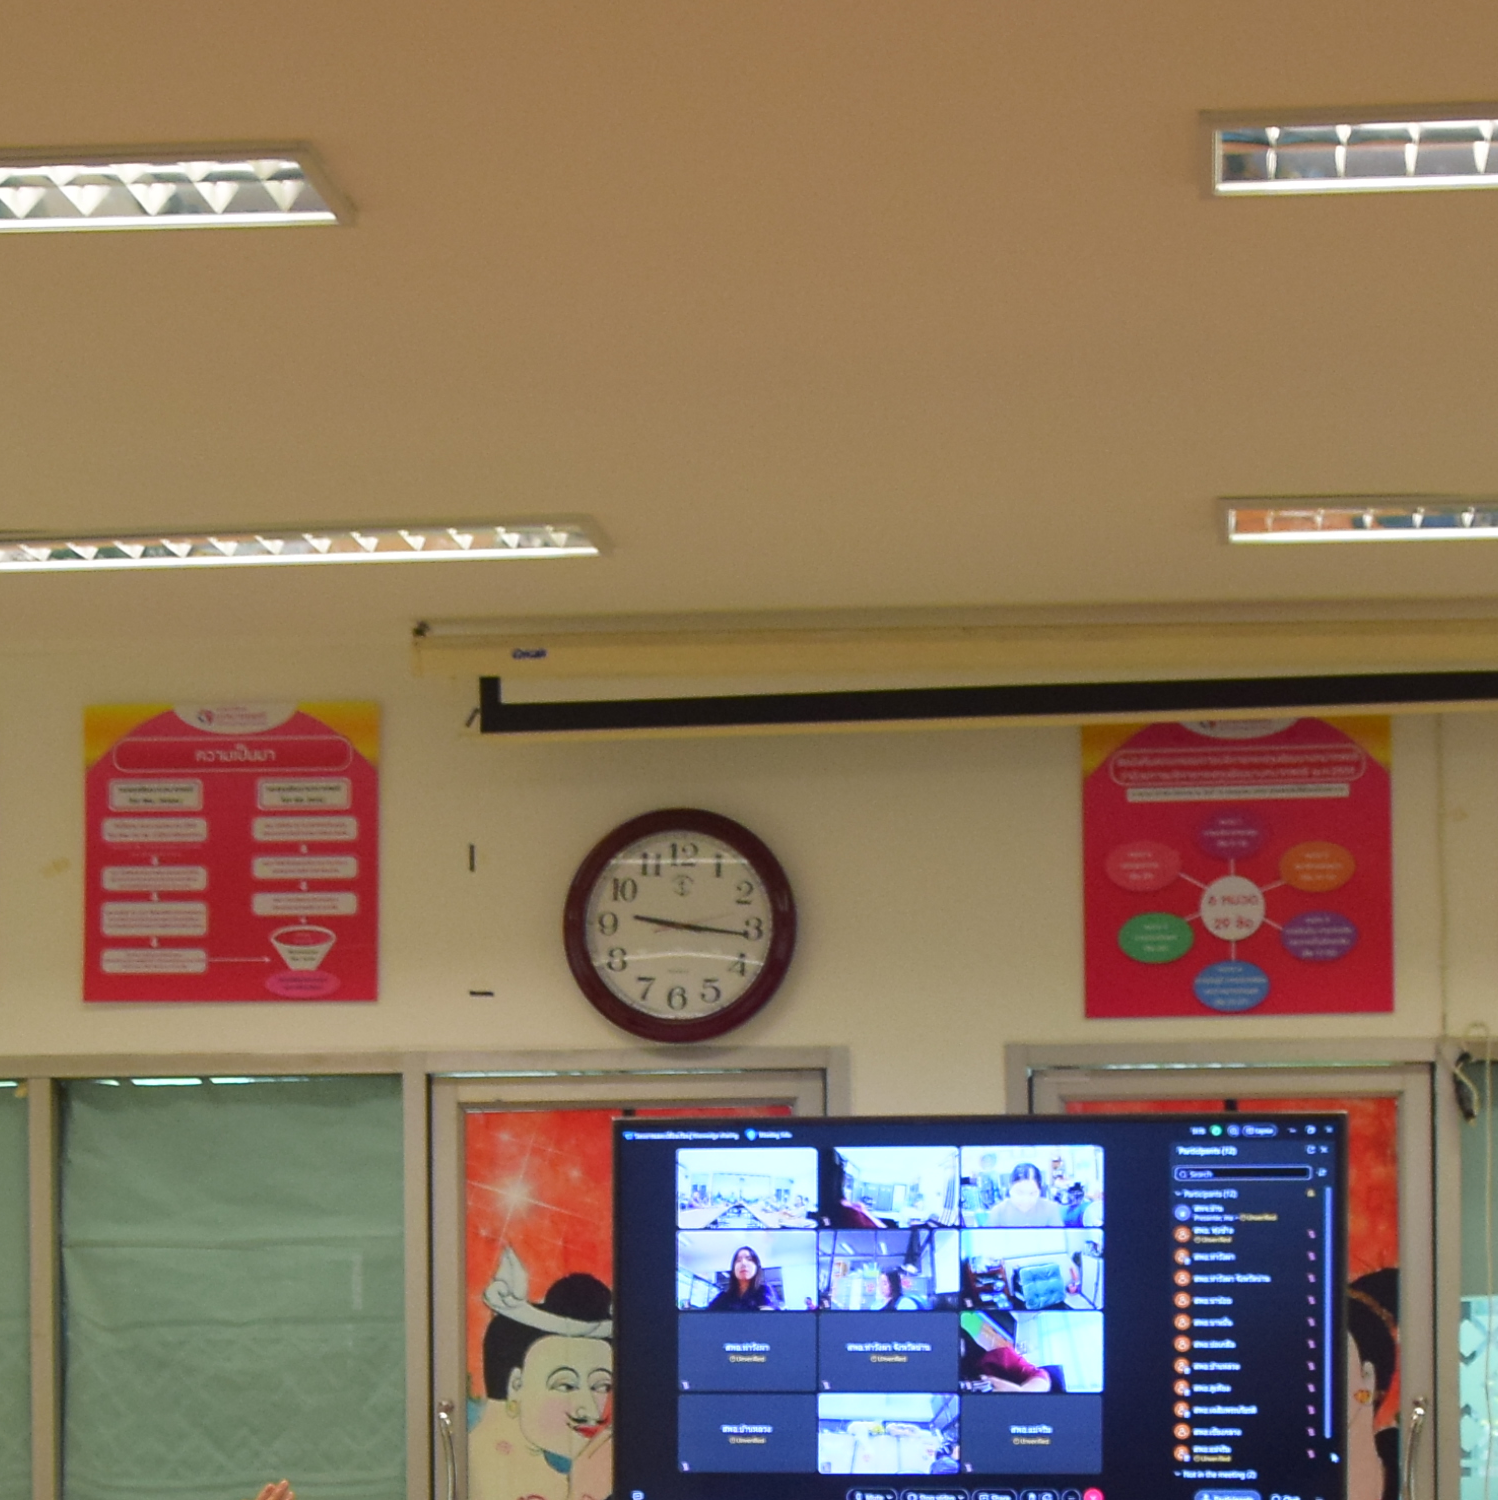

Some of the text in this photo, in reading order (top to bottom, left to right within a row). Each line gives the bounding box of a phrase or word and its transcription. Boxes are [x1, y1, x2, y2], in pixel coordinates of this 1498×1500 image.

[195, 743, 276, 763] ความเป็นมา
[641, 852, 661, 877] 11
[671, 842, 698, 867] 12
[714, 853, 723, 878] 1
[613, 877, 637, 901] 10
[735, 880, 754, 905] 2
[598, 911, 618, 936] 9
[745, 917, 763, 941] 3
[607, 947, 627, 972] 8
[728, 952, 746, 977] 4
[636, 976, 656, 1000] 7
[667, 985, 687, 1011] 6
[701, 977, 721, 1003] 5
[1177, 1146, 1238, 1156] Participants (12)
[1189, 1170, 1213, 1179] Search
[1184, 1189, 1238, 1199] Participants (12)
[724, 1342, 770, 1352] สพอ.ท่าวังผา
[736, 1355, 766, 1363] Unverified
[847, 1342, 891, 1352] สพอ.ท่าวังผา
[877, 1355, 907, 1363] Unverified
[736, 1437, 766, 1445] Unverified
[1183, 1471, 1196, 1479] Not
[1206, 1470, 1217, 1479] the
[1218, 1471, 1245, 1480] meeting
